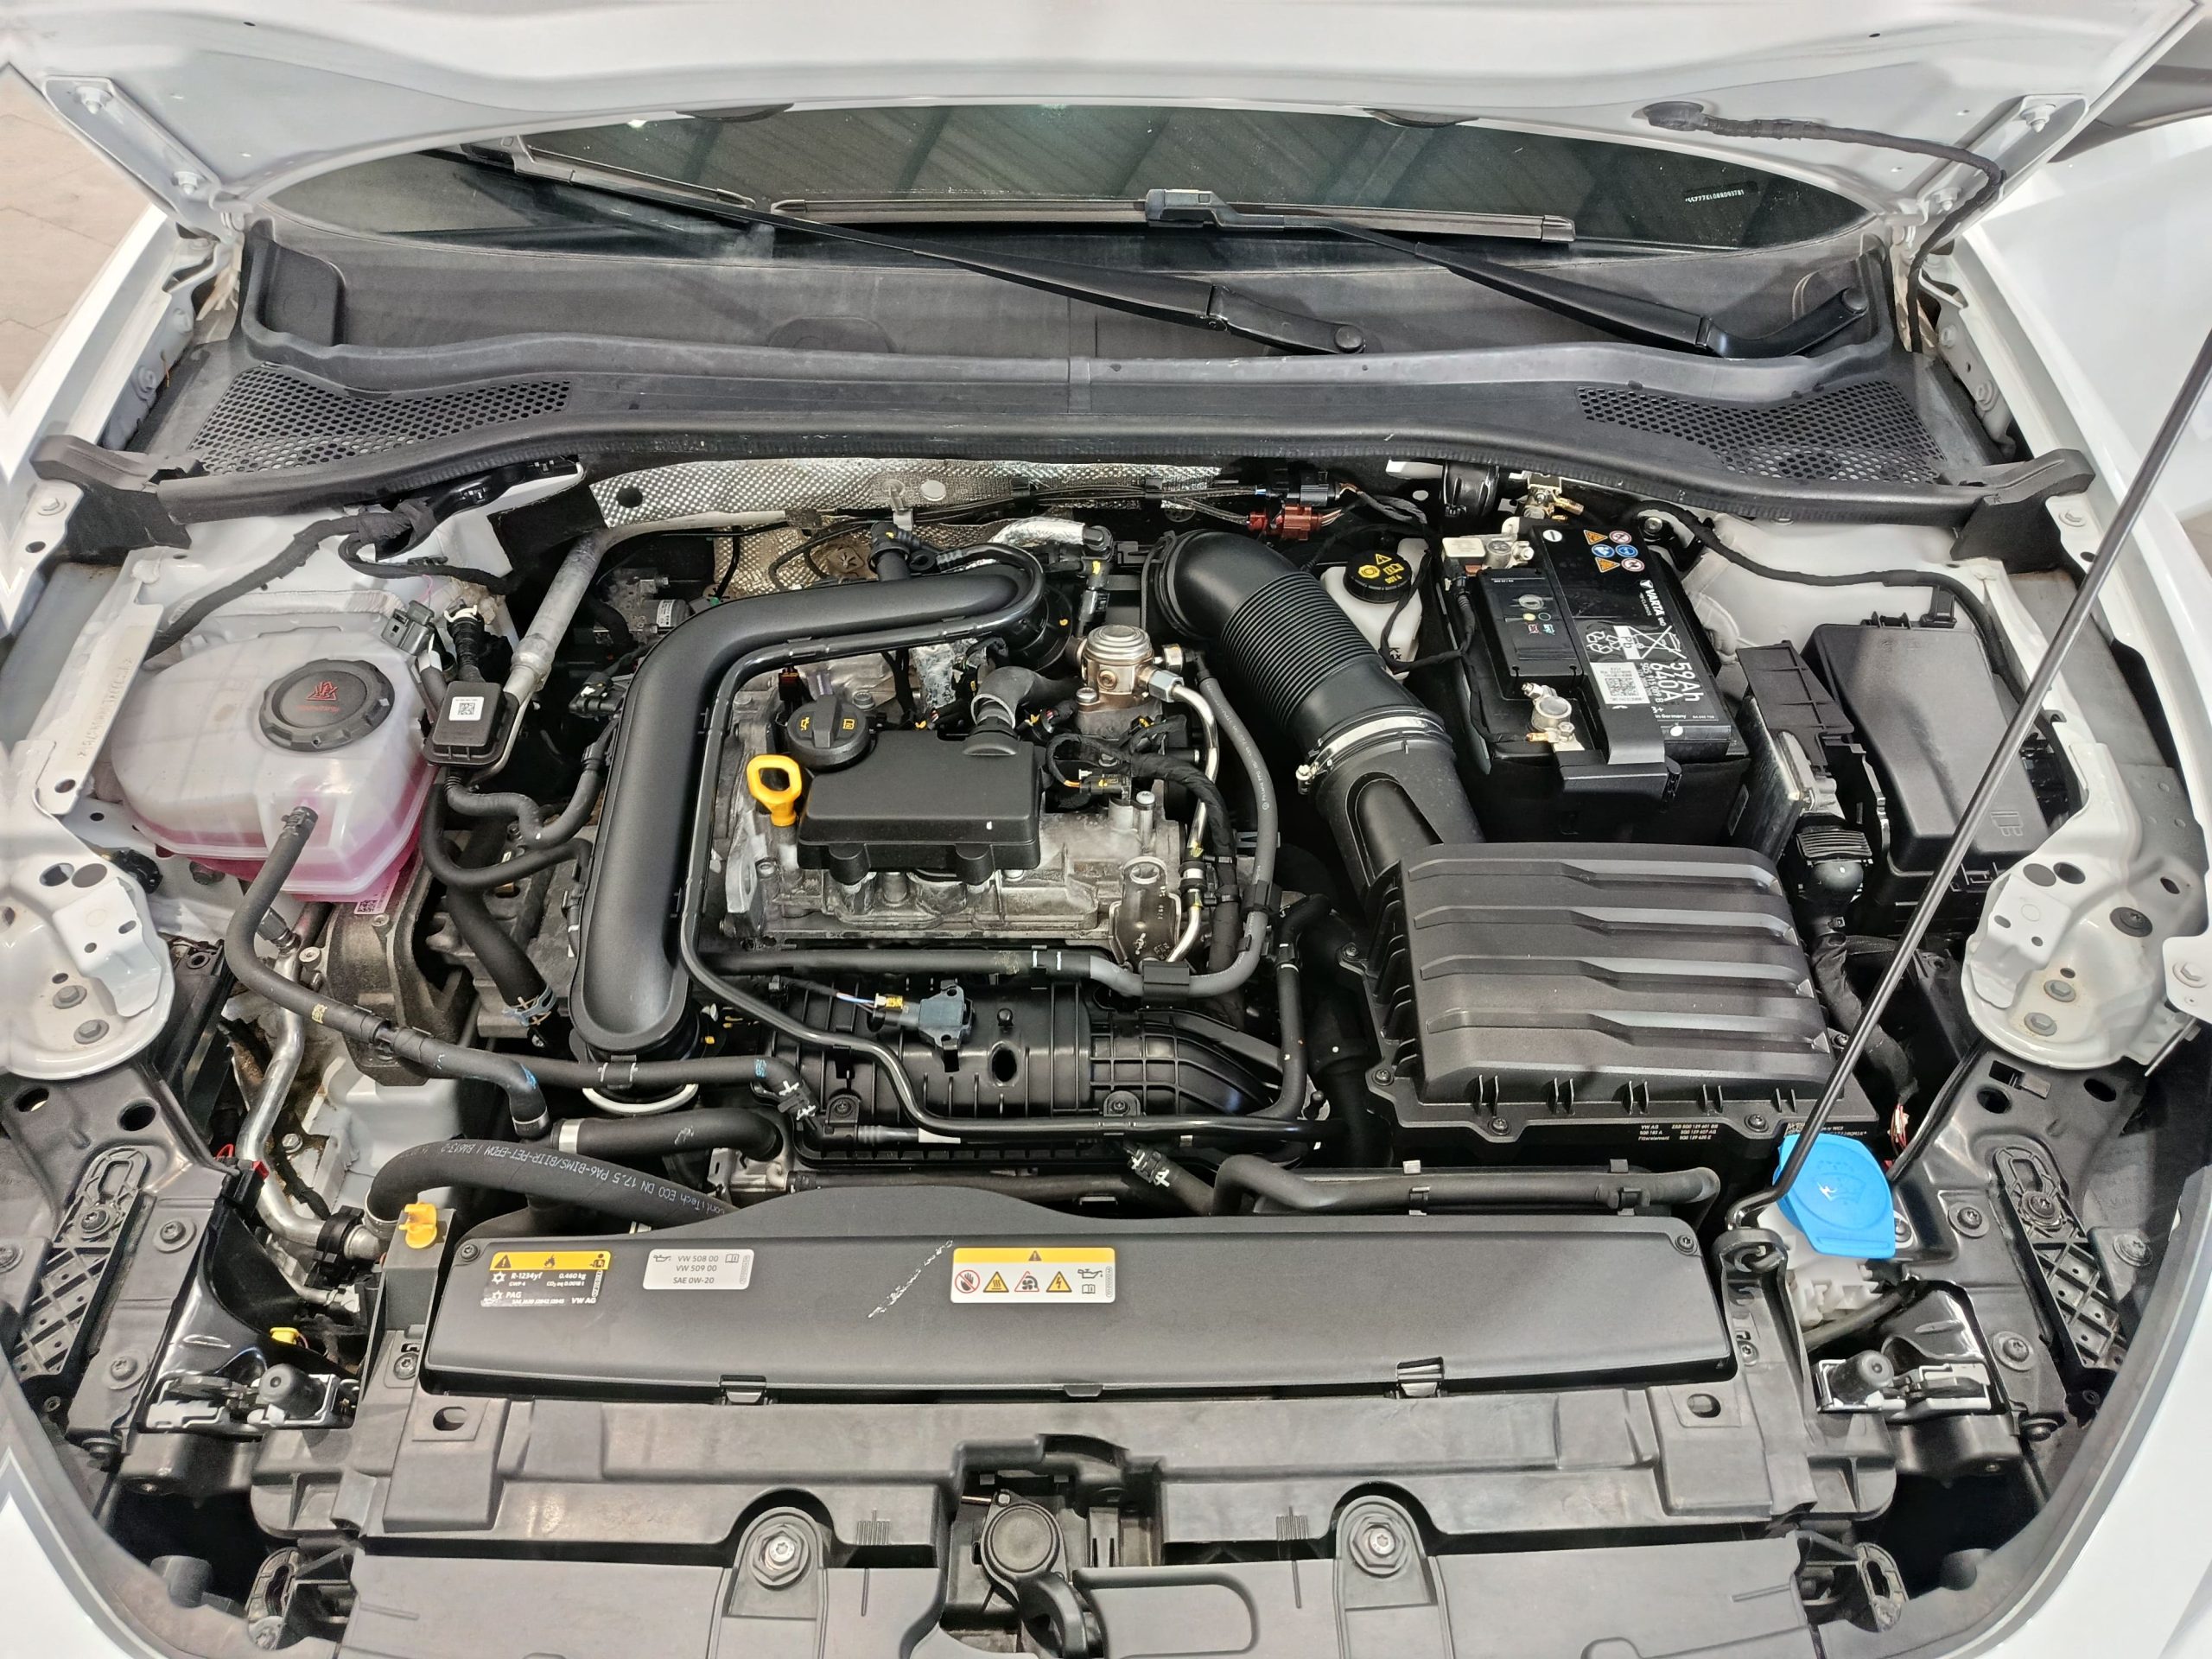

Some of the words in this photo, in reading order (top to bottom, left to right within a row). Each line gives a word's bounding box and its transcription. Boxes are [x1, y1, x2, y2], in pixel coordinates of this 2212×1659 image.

[1644, 588, 1666, 616] VARTA
[1650, 663, 1683, 702] 640A
[1670, 663, 1704, 702] 59Ah
[612, 1172, 637, 1188] 17.5
[639, 1179, 655, 1194] DN
[658, 1186, 677, 1202] ECO
[511, 1272, 543, 1281] R-1234yf
